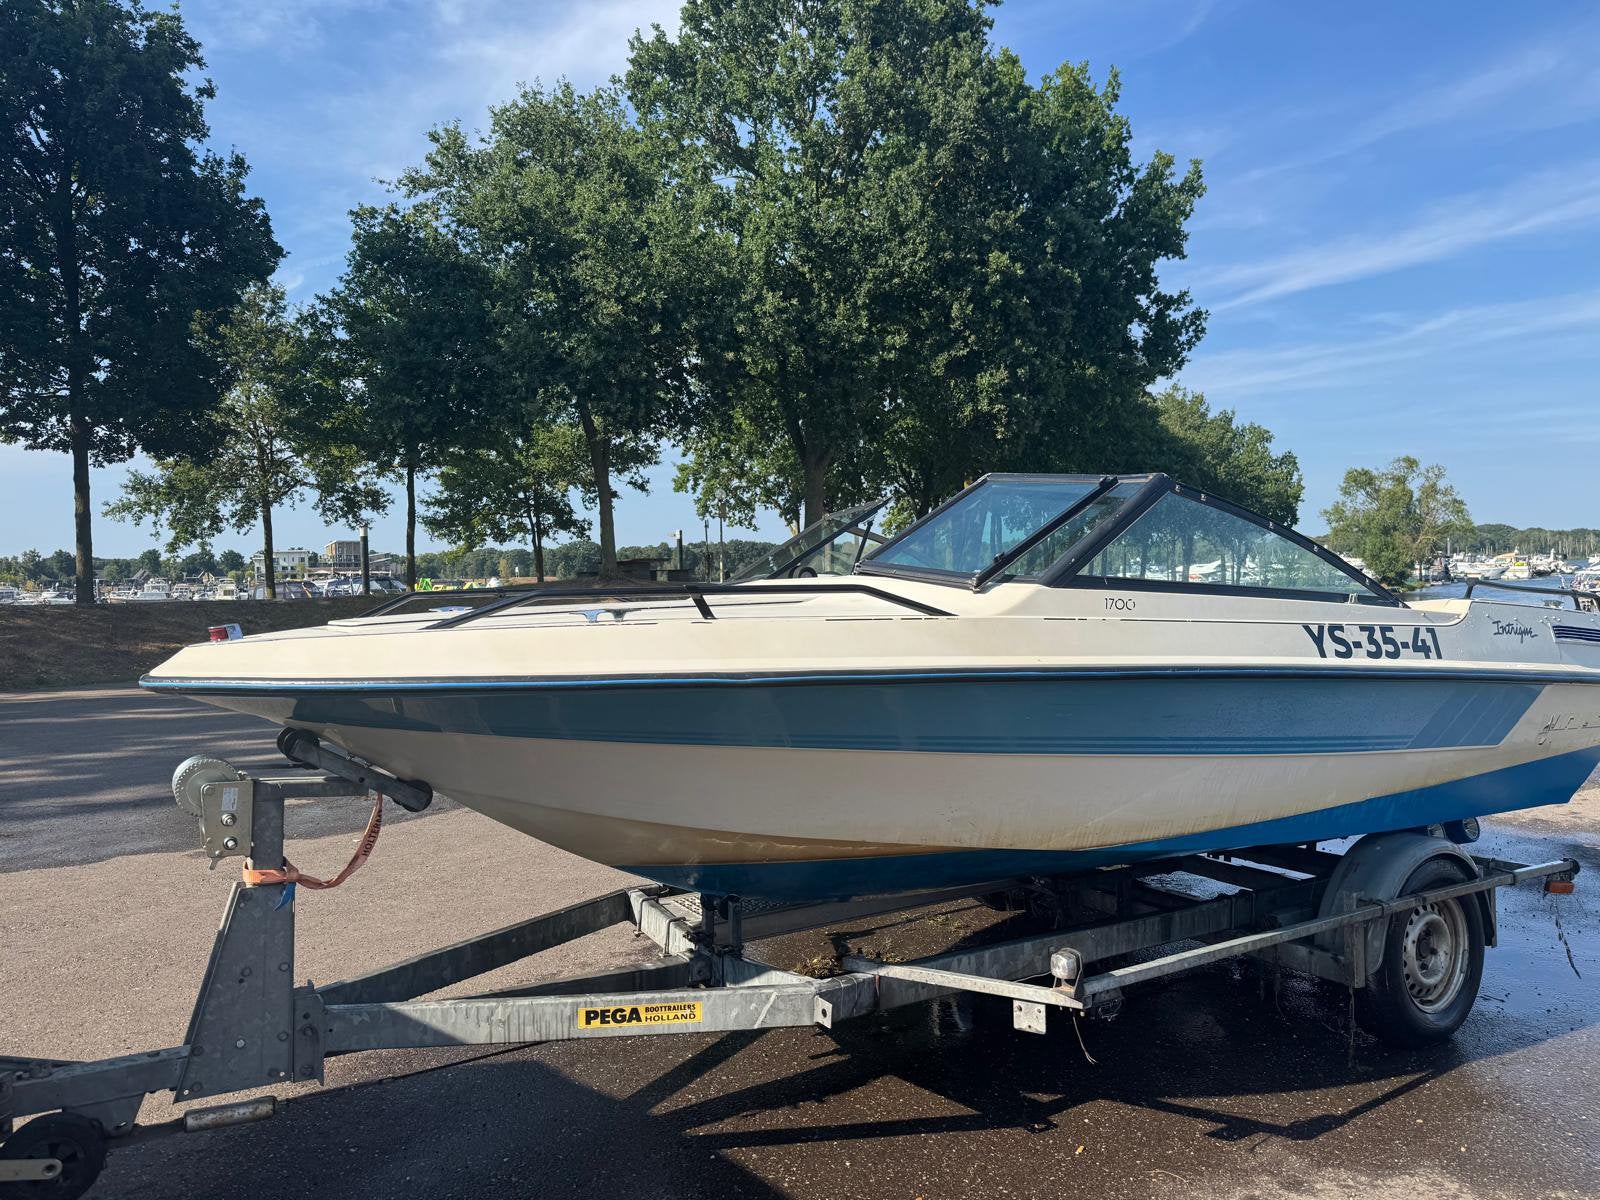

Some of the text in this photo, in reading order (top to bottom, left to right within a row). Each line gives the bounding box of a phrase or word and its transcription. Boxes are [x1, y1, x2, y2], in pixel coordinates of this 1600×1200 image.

[1105, 598, 1135, 610] 1700
[1492, 620, 1538, 644] Intrigue
[1302, 625, 1443, 660] YS-35-41
[645, 1003, 696, 1013] BOOTTRAILERS
[585, 1007, 643, 1025] PEGA
[645, 1012, 696, 1022] HOLLAND
